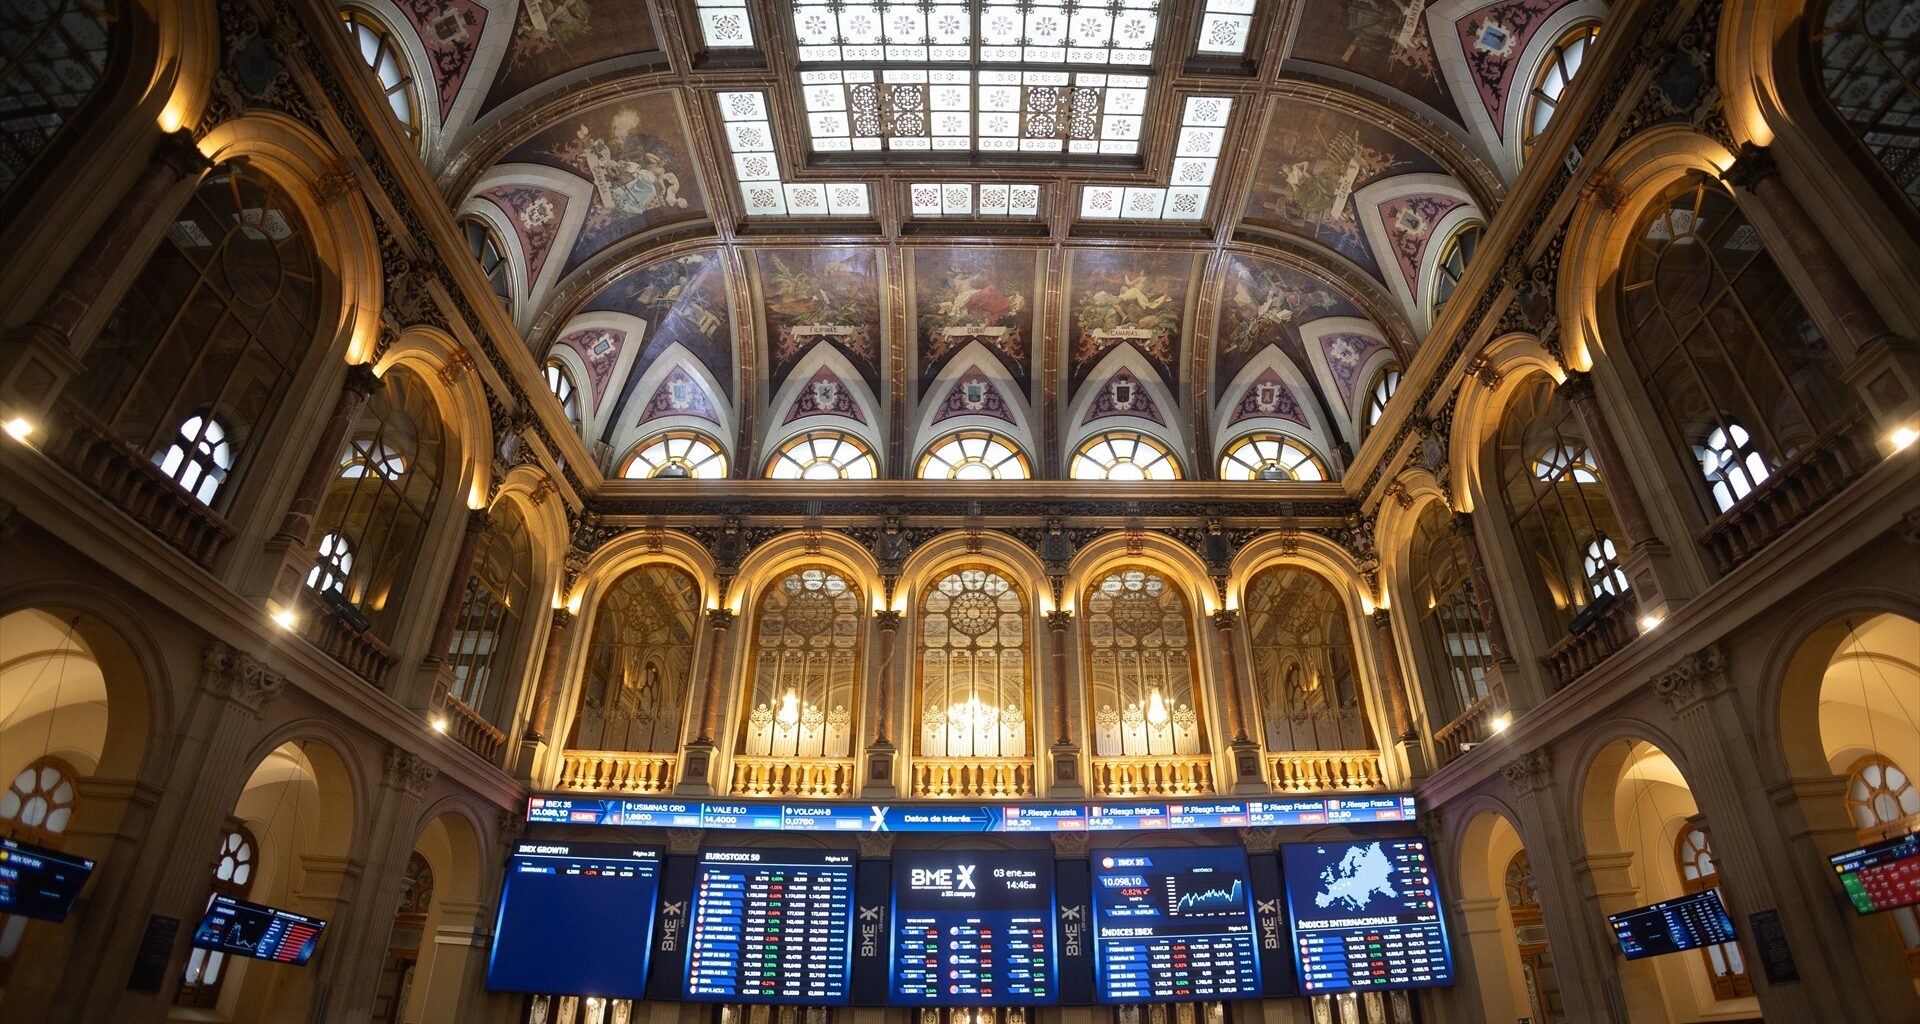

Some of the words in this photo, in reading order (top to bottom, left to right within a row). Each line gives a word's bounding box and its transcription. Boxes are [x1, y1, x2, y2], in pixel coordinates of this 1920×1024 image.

[546, 800, 562, 808] IBEX
[633, 803, 668, 811] USIMINAS
[1264, 804, 1293, 812] P.Riesgo
[1341, 801, 1369, 809] P.Riesgo
[793, 808, 831, 816] VOLCAN-B
[1021, 809, 1052, 817] P.Riesgo
[1052, 809, 1077, 817] Austria
[1103, 808, 1134, 817] P.Riesgo
[1135, 807, 1160, 816] Bélgica
[1184, 806, 1214, 814] P.Riesgo
[1215, 805, 1240, 814] España
[704, 816, 736, 824] 14,4000
[519, 845, 536, 853] IBEX
[537, 846, 568, 854] GROWTH
[705, 852, 750, 861] EUROSTOXX
[1135, 858, 1144, 866] 35
[911, 869, 952, 886] BME
[993, 869, 1004, 877] 03
[1103, 877, 1141, 886] 10.098,10
[1120, 888, 1141, 896] -0,82%
[1298, 920, 1329, 929] ÍNDICES
[1330, 916, 1397, 928] INTERNACIONALES
[661, 918, 677, 951] BME
[1102, 927, 1134, 937] ÍNDICES
[1134, 927, 1153, 936] IBEX
[1262, 917, 1277, 949] BME
[861, 924, 874, 957] BME
[1065, 924, 1078, 956] BME
